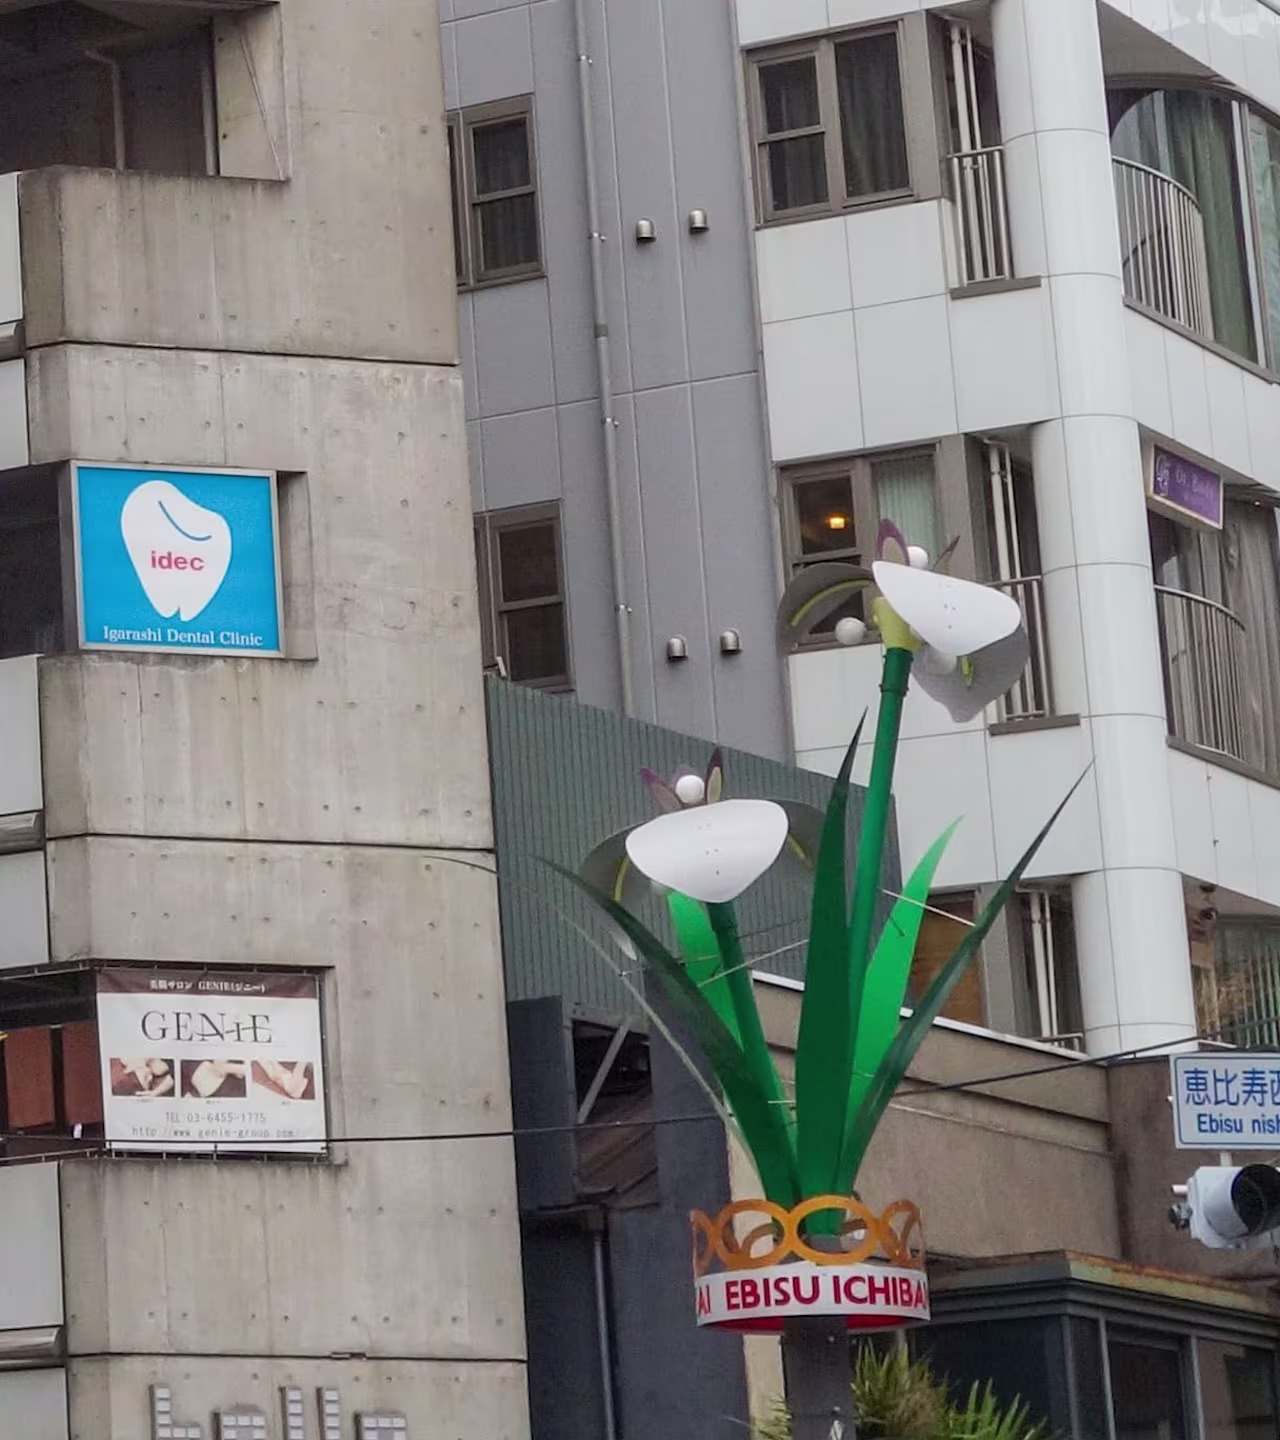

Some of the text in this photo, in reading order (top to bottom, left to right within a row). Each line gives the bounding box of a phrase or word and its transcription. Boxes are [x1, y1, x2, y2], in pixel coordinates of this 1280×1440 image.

[151, 550, 205, 571] idec
[103, 625, 263, 647] Igarashi Dental Clinic
[1197, 1112, 1243, 1134] Ebisu
[725, 1275, 820, 1312] EBISU
